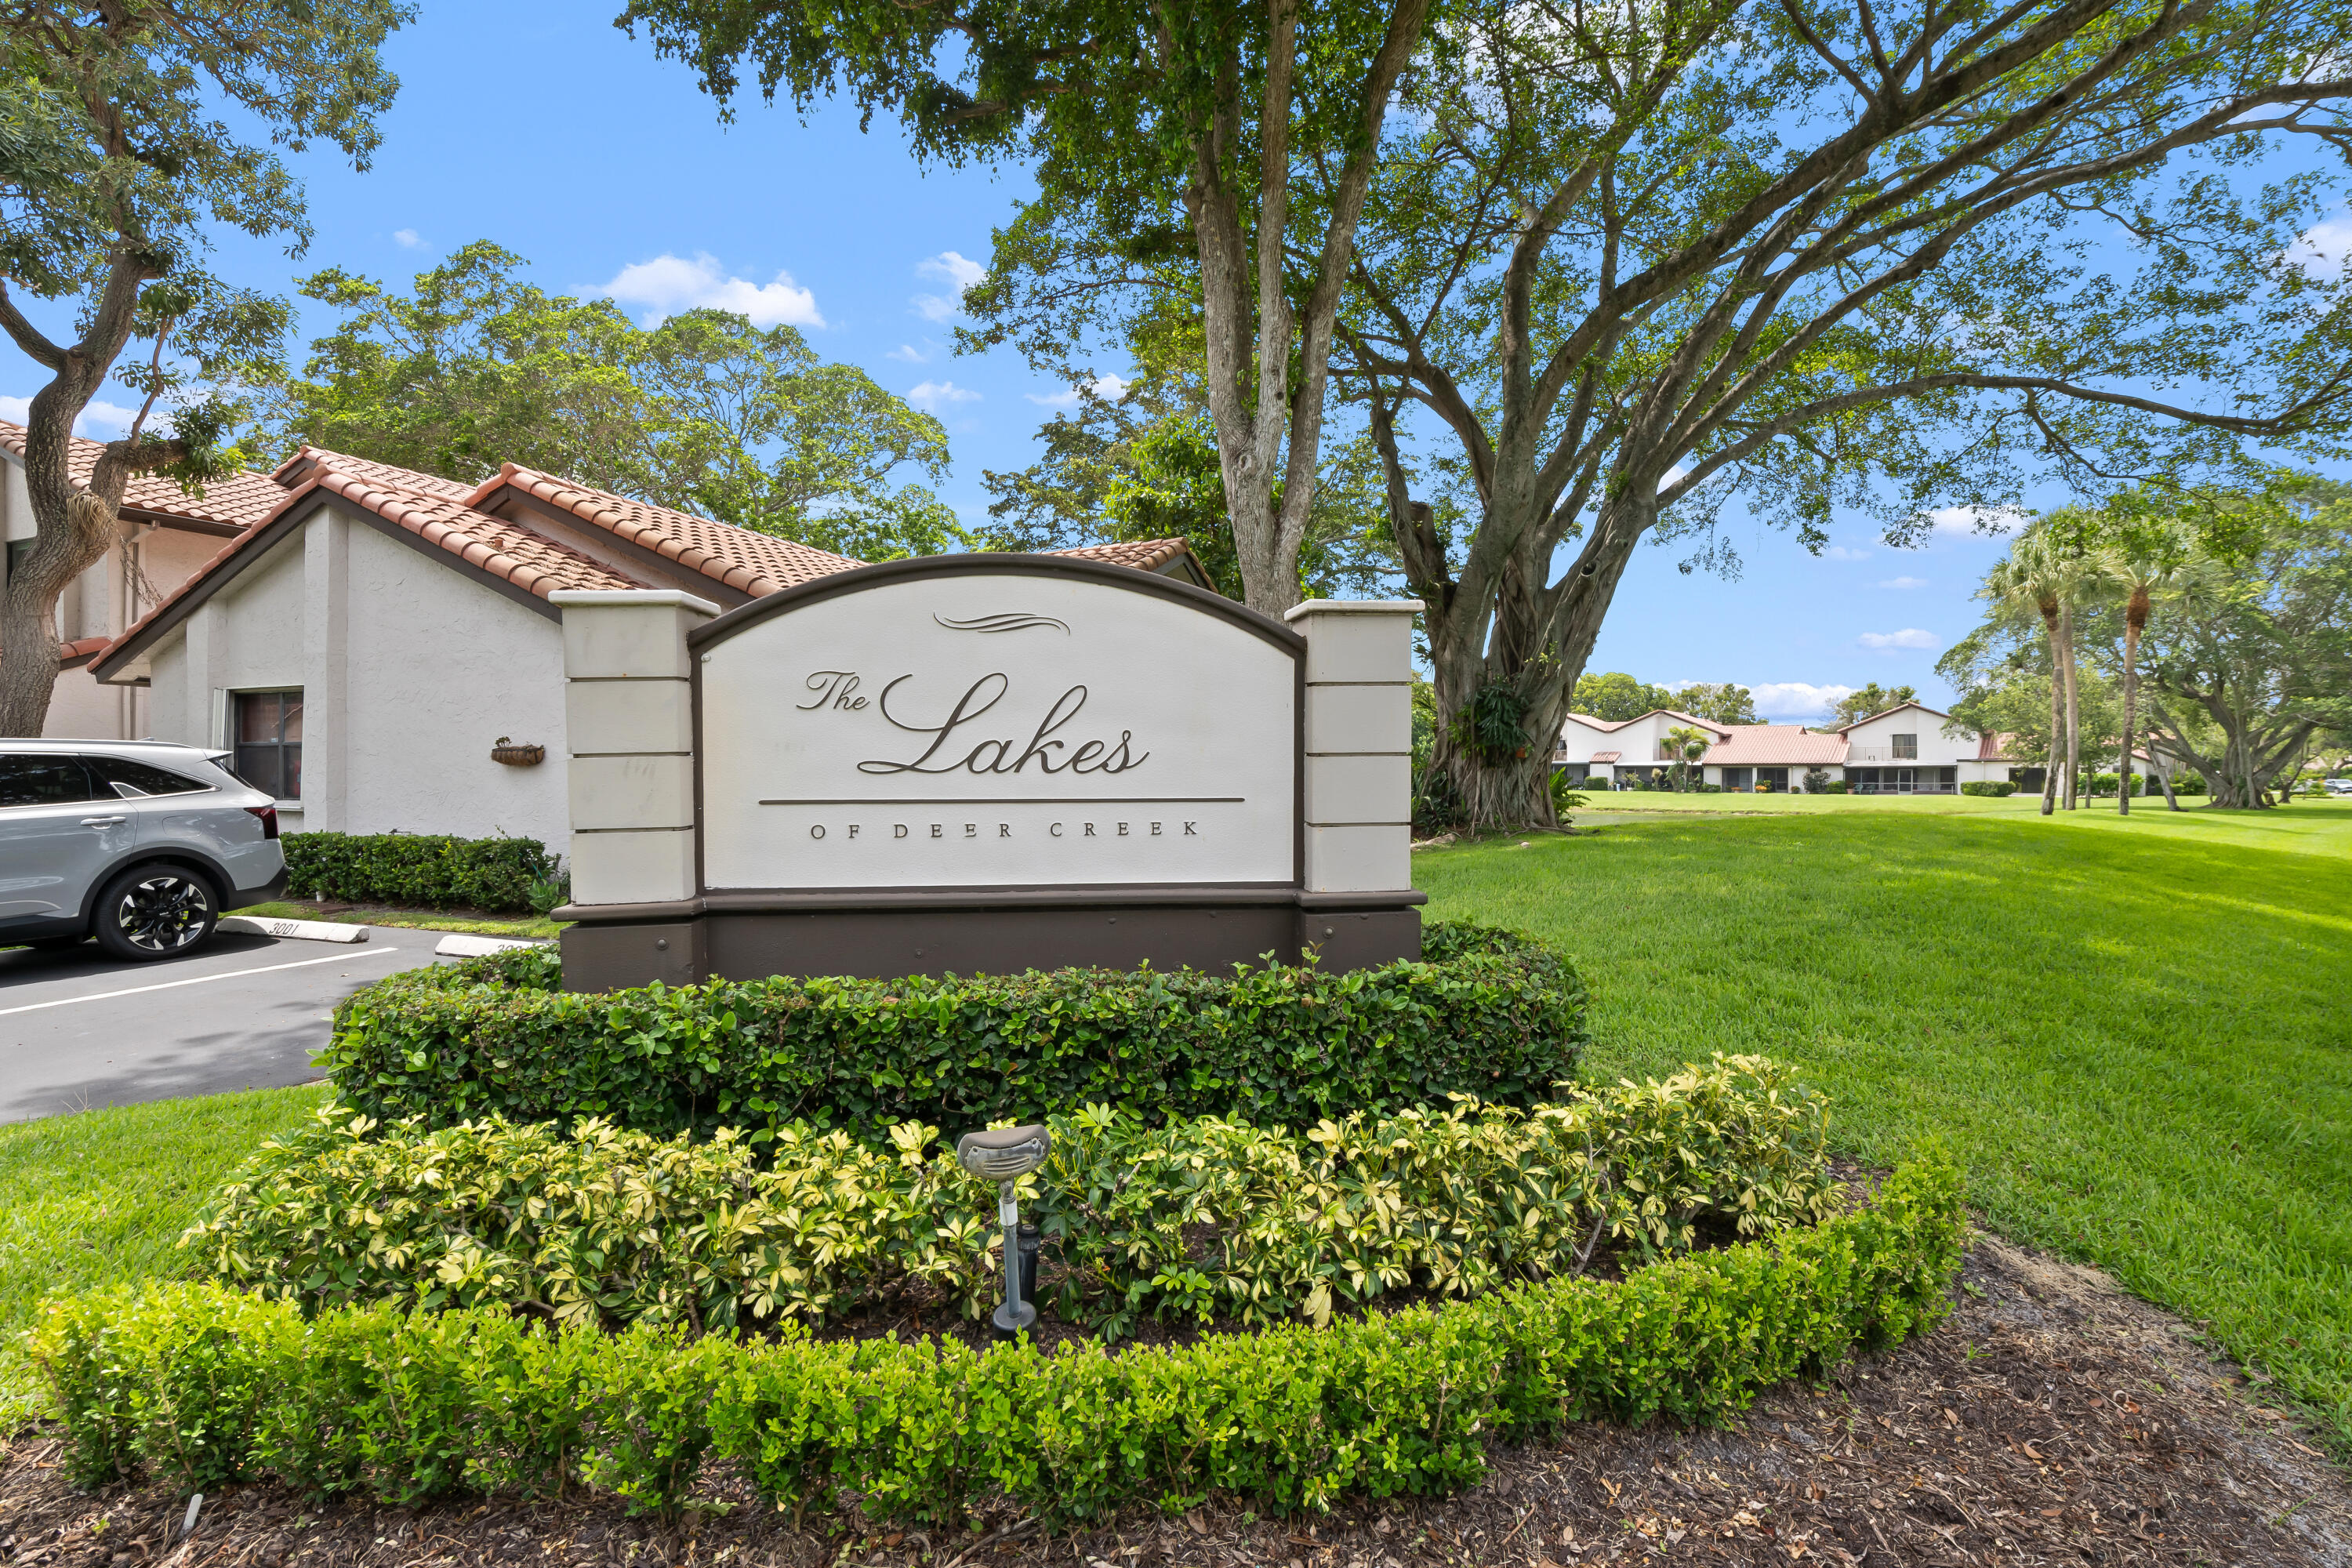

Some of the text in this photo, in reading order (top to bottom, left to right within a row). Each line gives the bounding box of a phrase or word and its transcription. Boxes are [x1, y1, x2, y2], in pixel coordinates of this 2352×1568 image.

[797, 670, 1150, 775] The Lakes
[811, 821, 1197, 840] OF DEER CREEK
[268, 922, 300, 935] 3001
